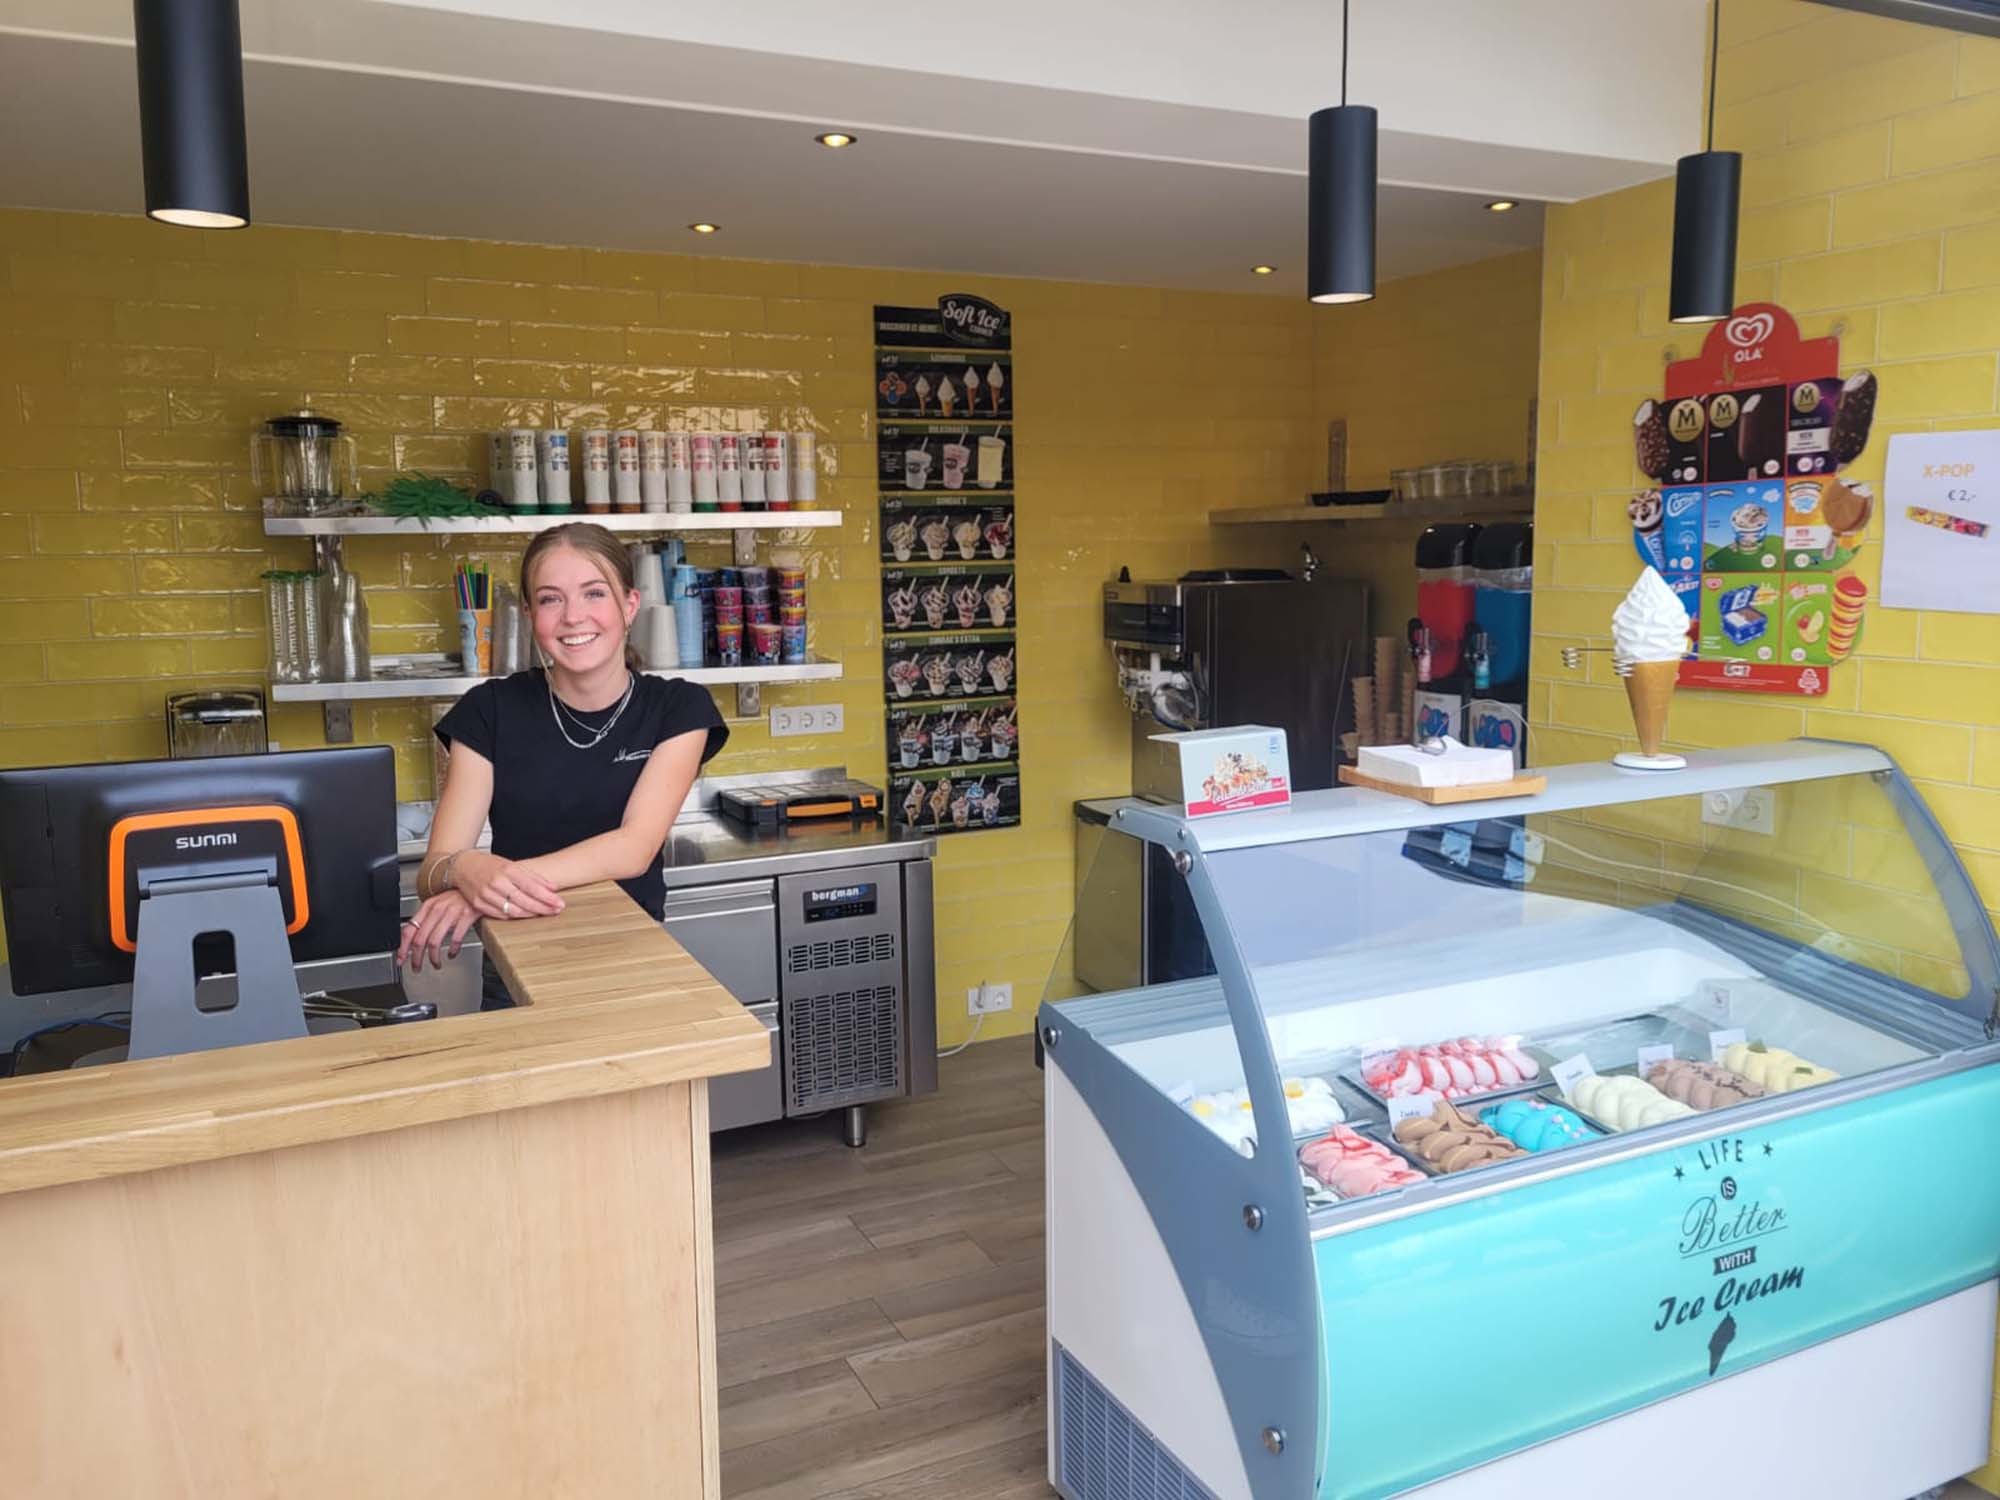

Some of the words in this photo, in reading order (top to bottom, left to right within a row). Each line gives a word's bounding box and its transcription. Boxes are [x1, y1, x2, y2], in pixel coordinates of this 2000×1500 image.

[944, 300, 974, 327] Soft
[977, 308, 1000, 329] Ice
[1733, 348, 1762, 363] OLA
[1922, 462, 1975, 479] X-POP
[811, 887, 860, 902] bergman
[1698, 1138, 1743, 1171] LIFE
[1721, 1180, 1736, 1198] IS
[1679, 1195, 1788, 1255] Better
[1718, 1250, 1752, 1272] WITH
[1654, 1296, 1705, 1332] Ice
[1713, 1266, 1805, 1312] Cream
